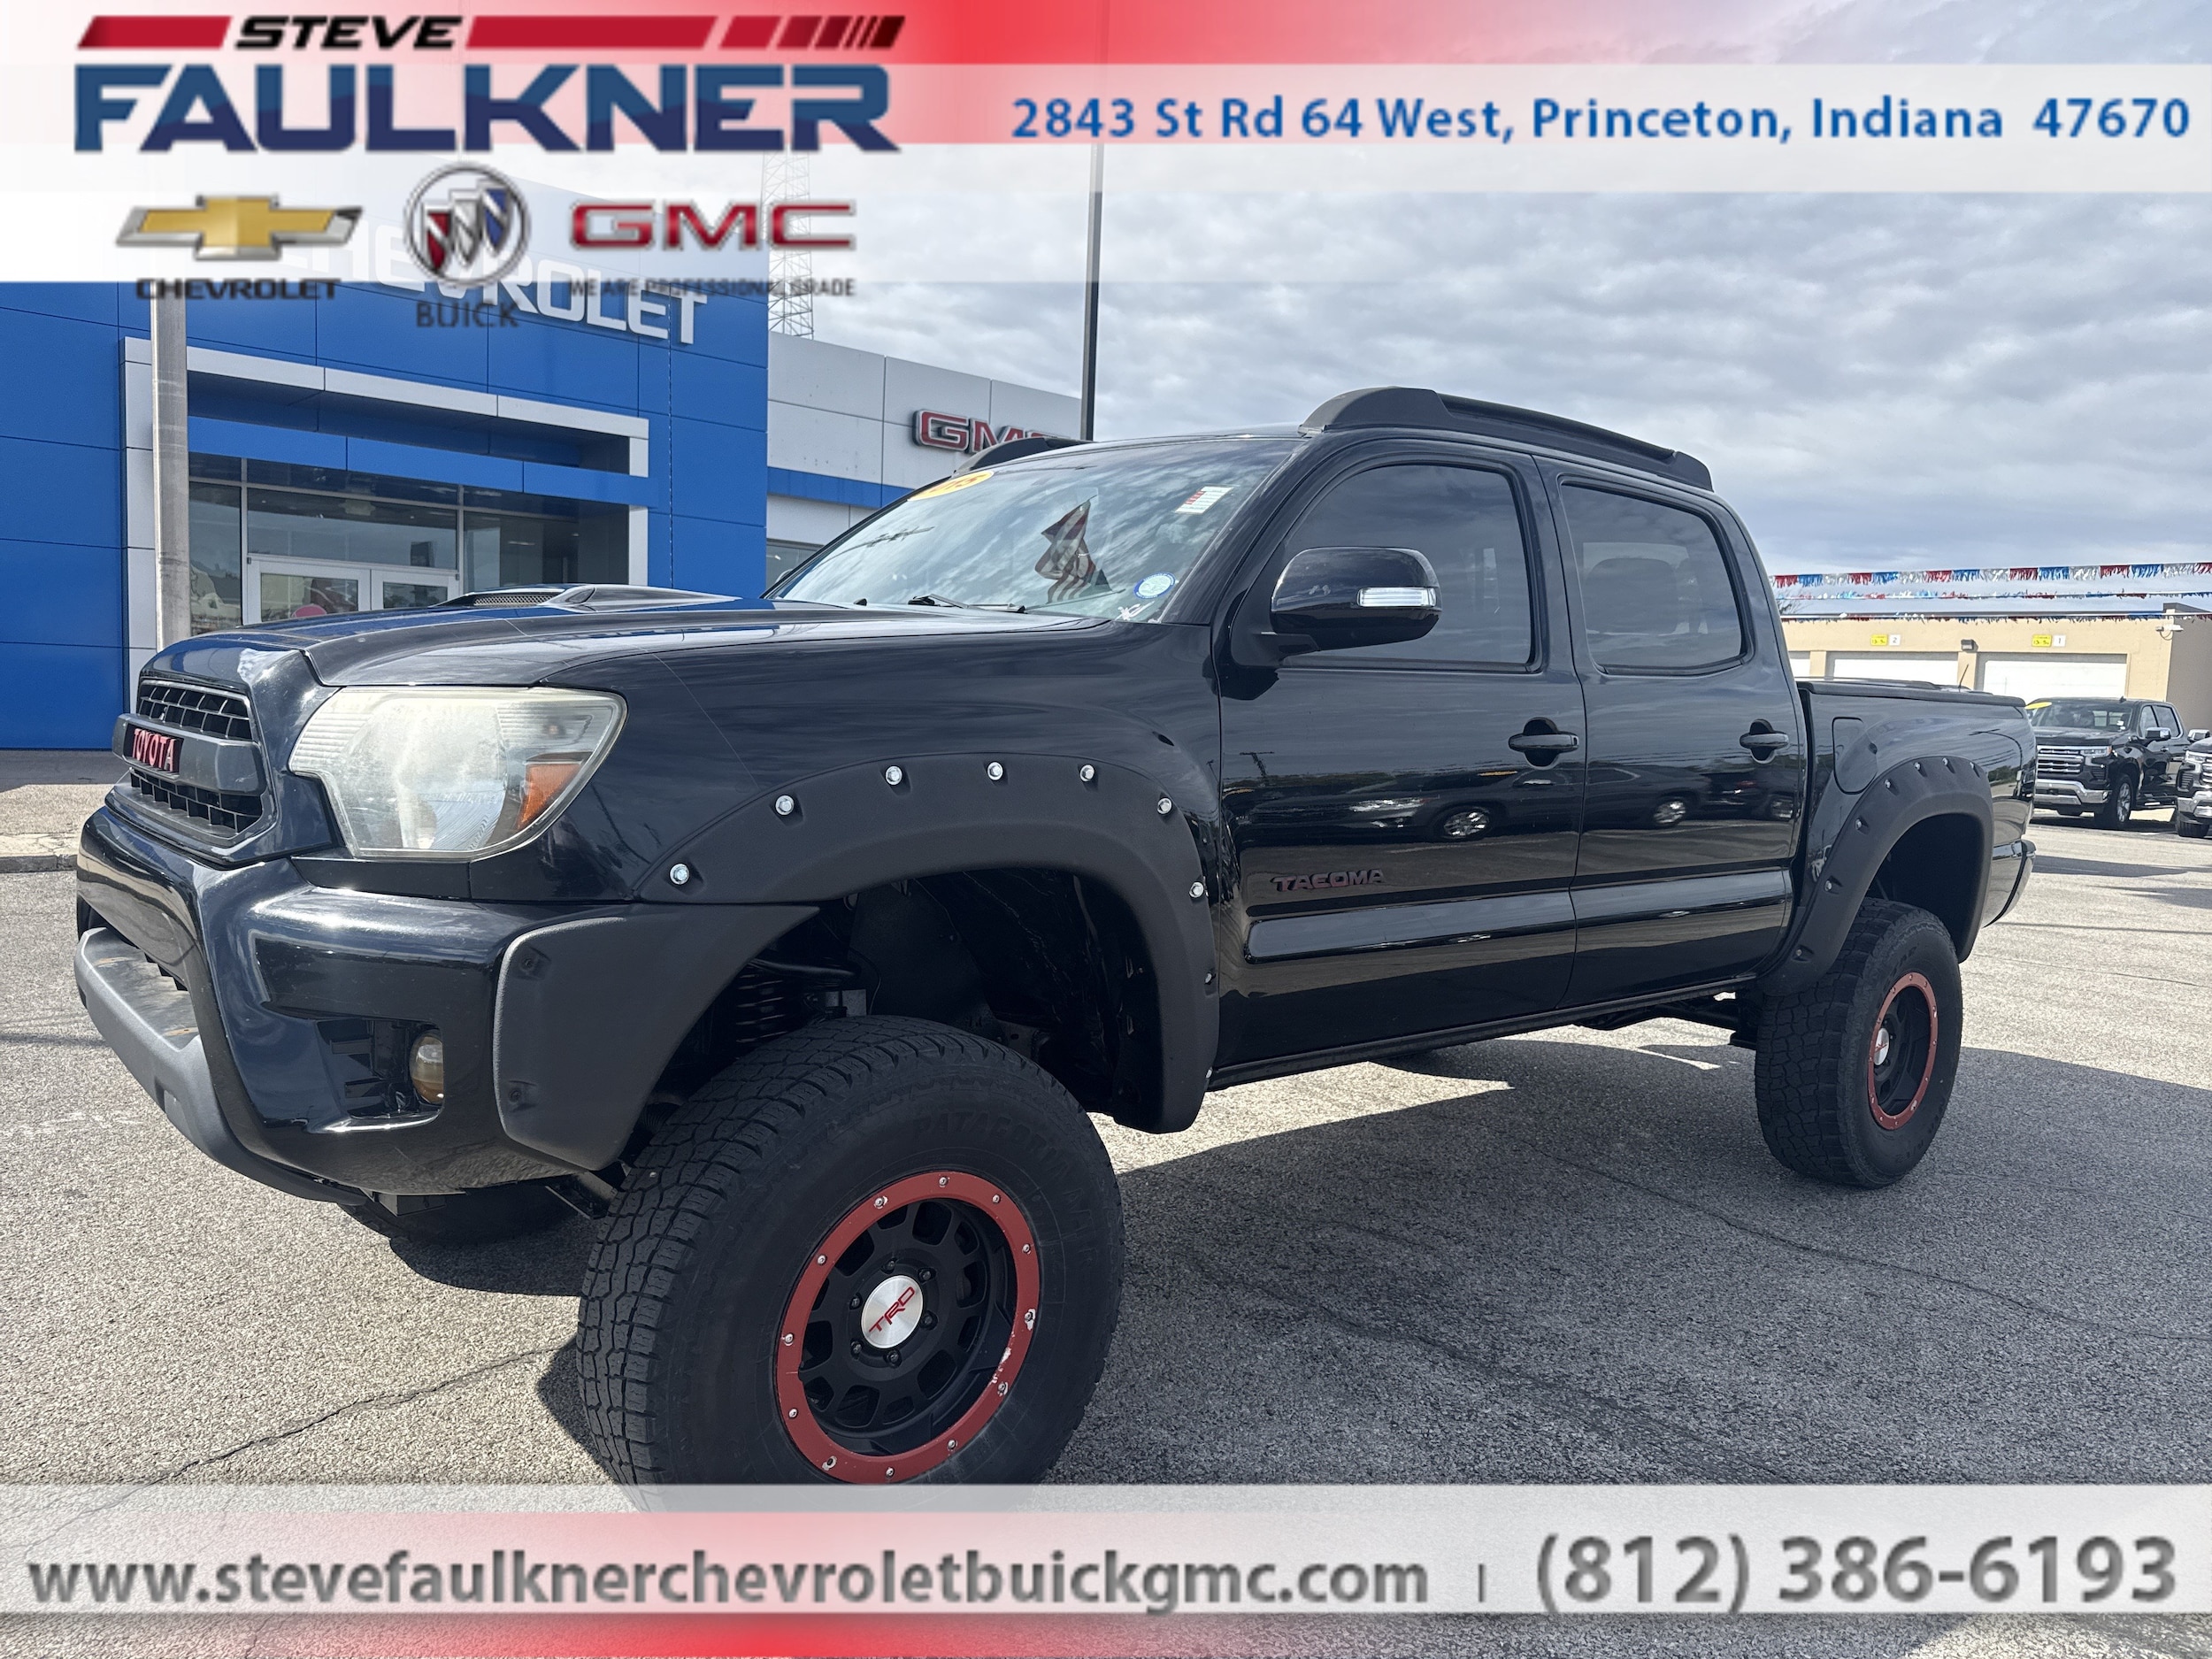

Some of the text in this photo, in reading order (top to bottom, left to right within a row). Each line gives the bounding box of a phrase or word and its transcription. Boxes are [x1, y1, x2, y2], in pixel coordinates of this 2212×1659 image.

[912, 409, 1069, 453] GM
[133, 728, 176, 772] TOYOTA
[1271, 868, 1386, 892] TACOMA
[869, 1286, 916, 1333] TRD
